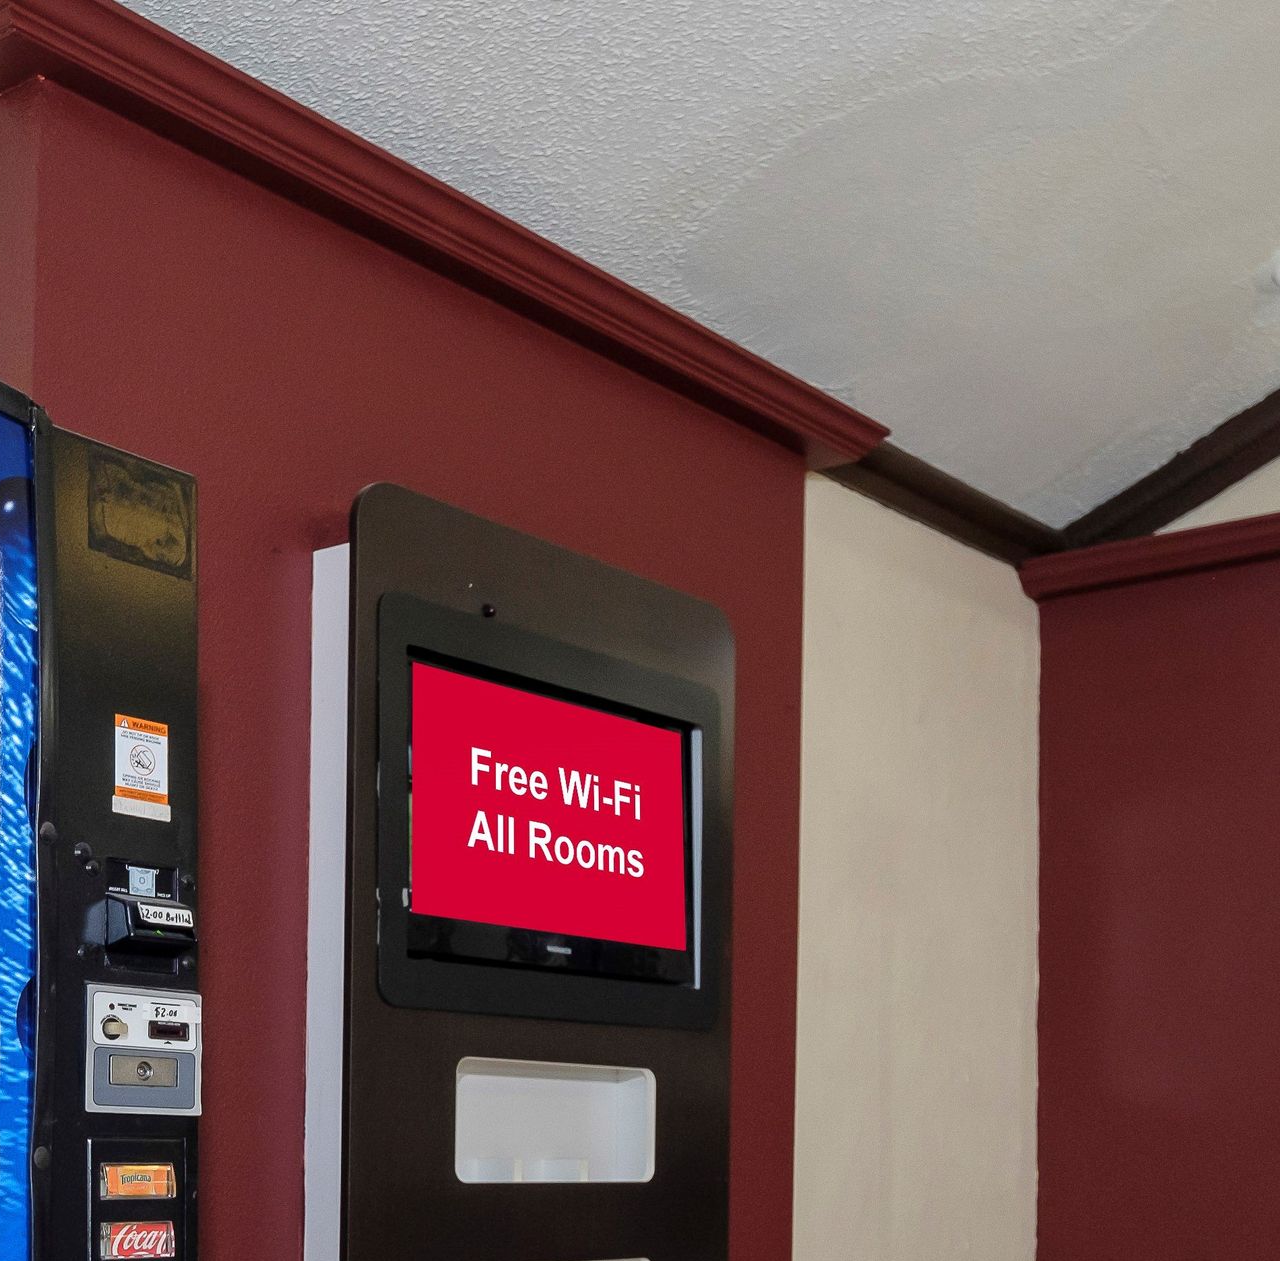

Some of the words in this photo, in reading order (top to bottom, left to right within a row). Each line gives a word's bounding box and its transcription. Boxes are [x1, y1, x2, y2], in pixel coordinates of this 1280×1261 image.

[132, 720, 167, 735] WARNING
[471, 746, 548, 800] Free
[558, 767, 641, 820] Wi-Fi
[467, 810, 515, 855] All
[528, 820, 645, 878] Rooms
[120, 1173, 152, 1185] Tropicana
